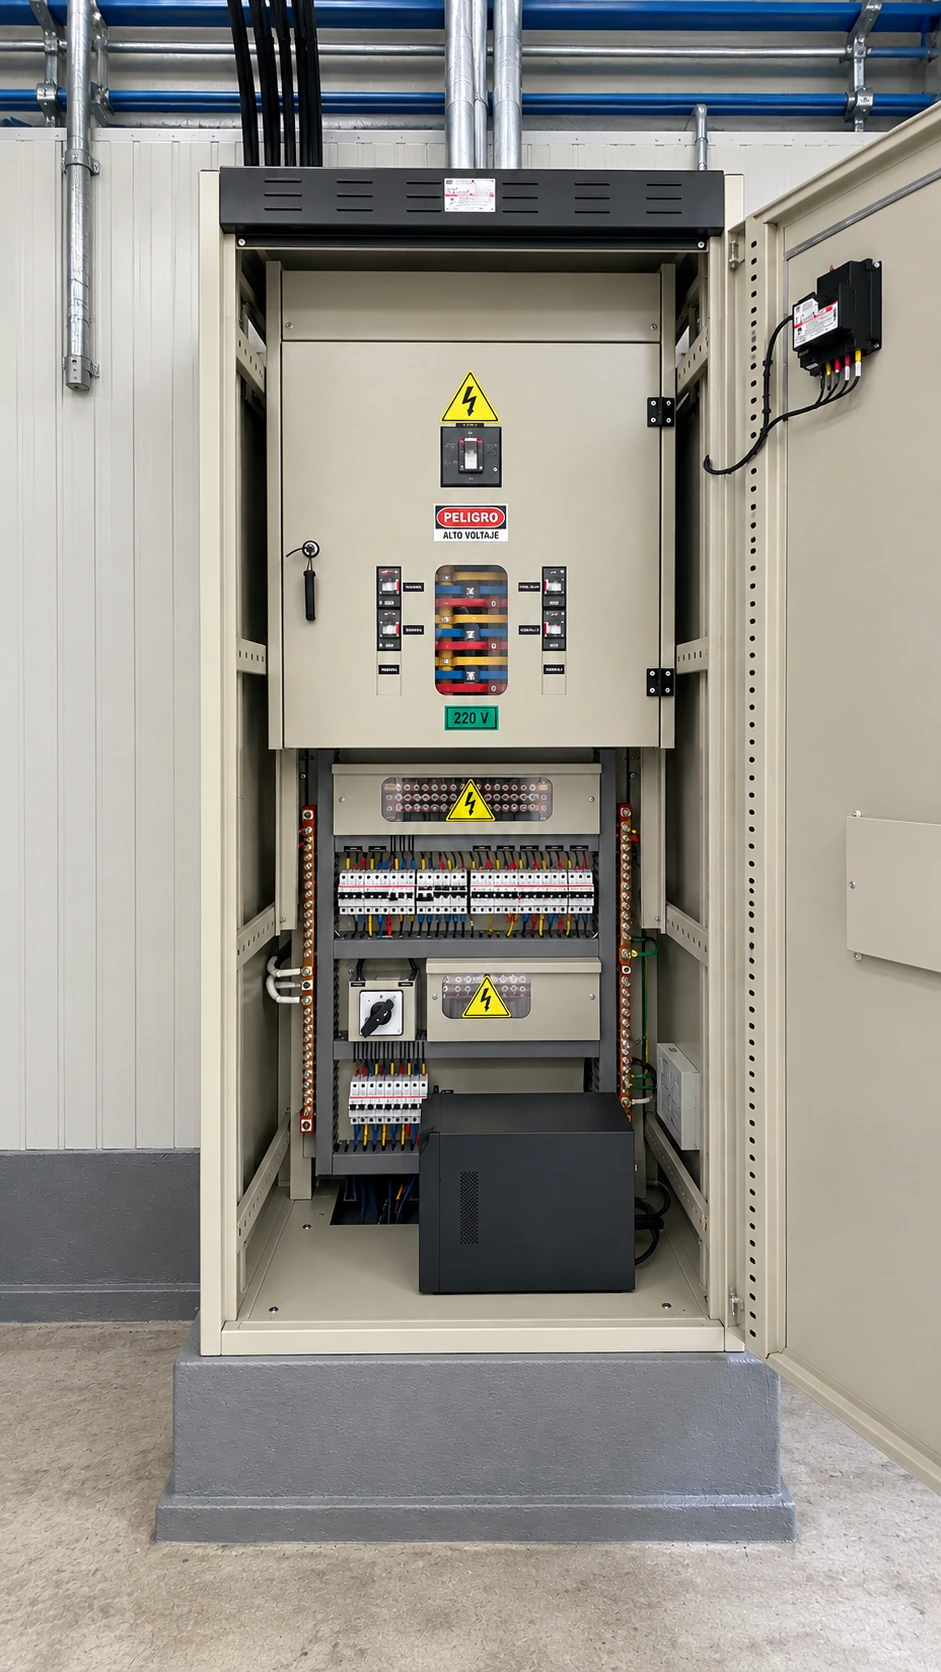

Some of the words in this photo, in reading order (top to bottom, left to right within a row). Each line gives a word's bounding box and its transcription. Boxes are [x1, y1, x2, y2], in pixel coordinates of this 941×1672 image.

[444, 512, 498, 523] PELIGRO
[443, 531, 463, 539] ALTO
[465, 531, 499, 539] VOLTAJE
[454, 712, 476, 724] 220
[480, 712, 489, 724] V
